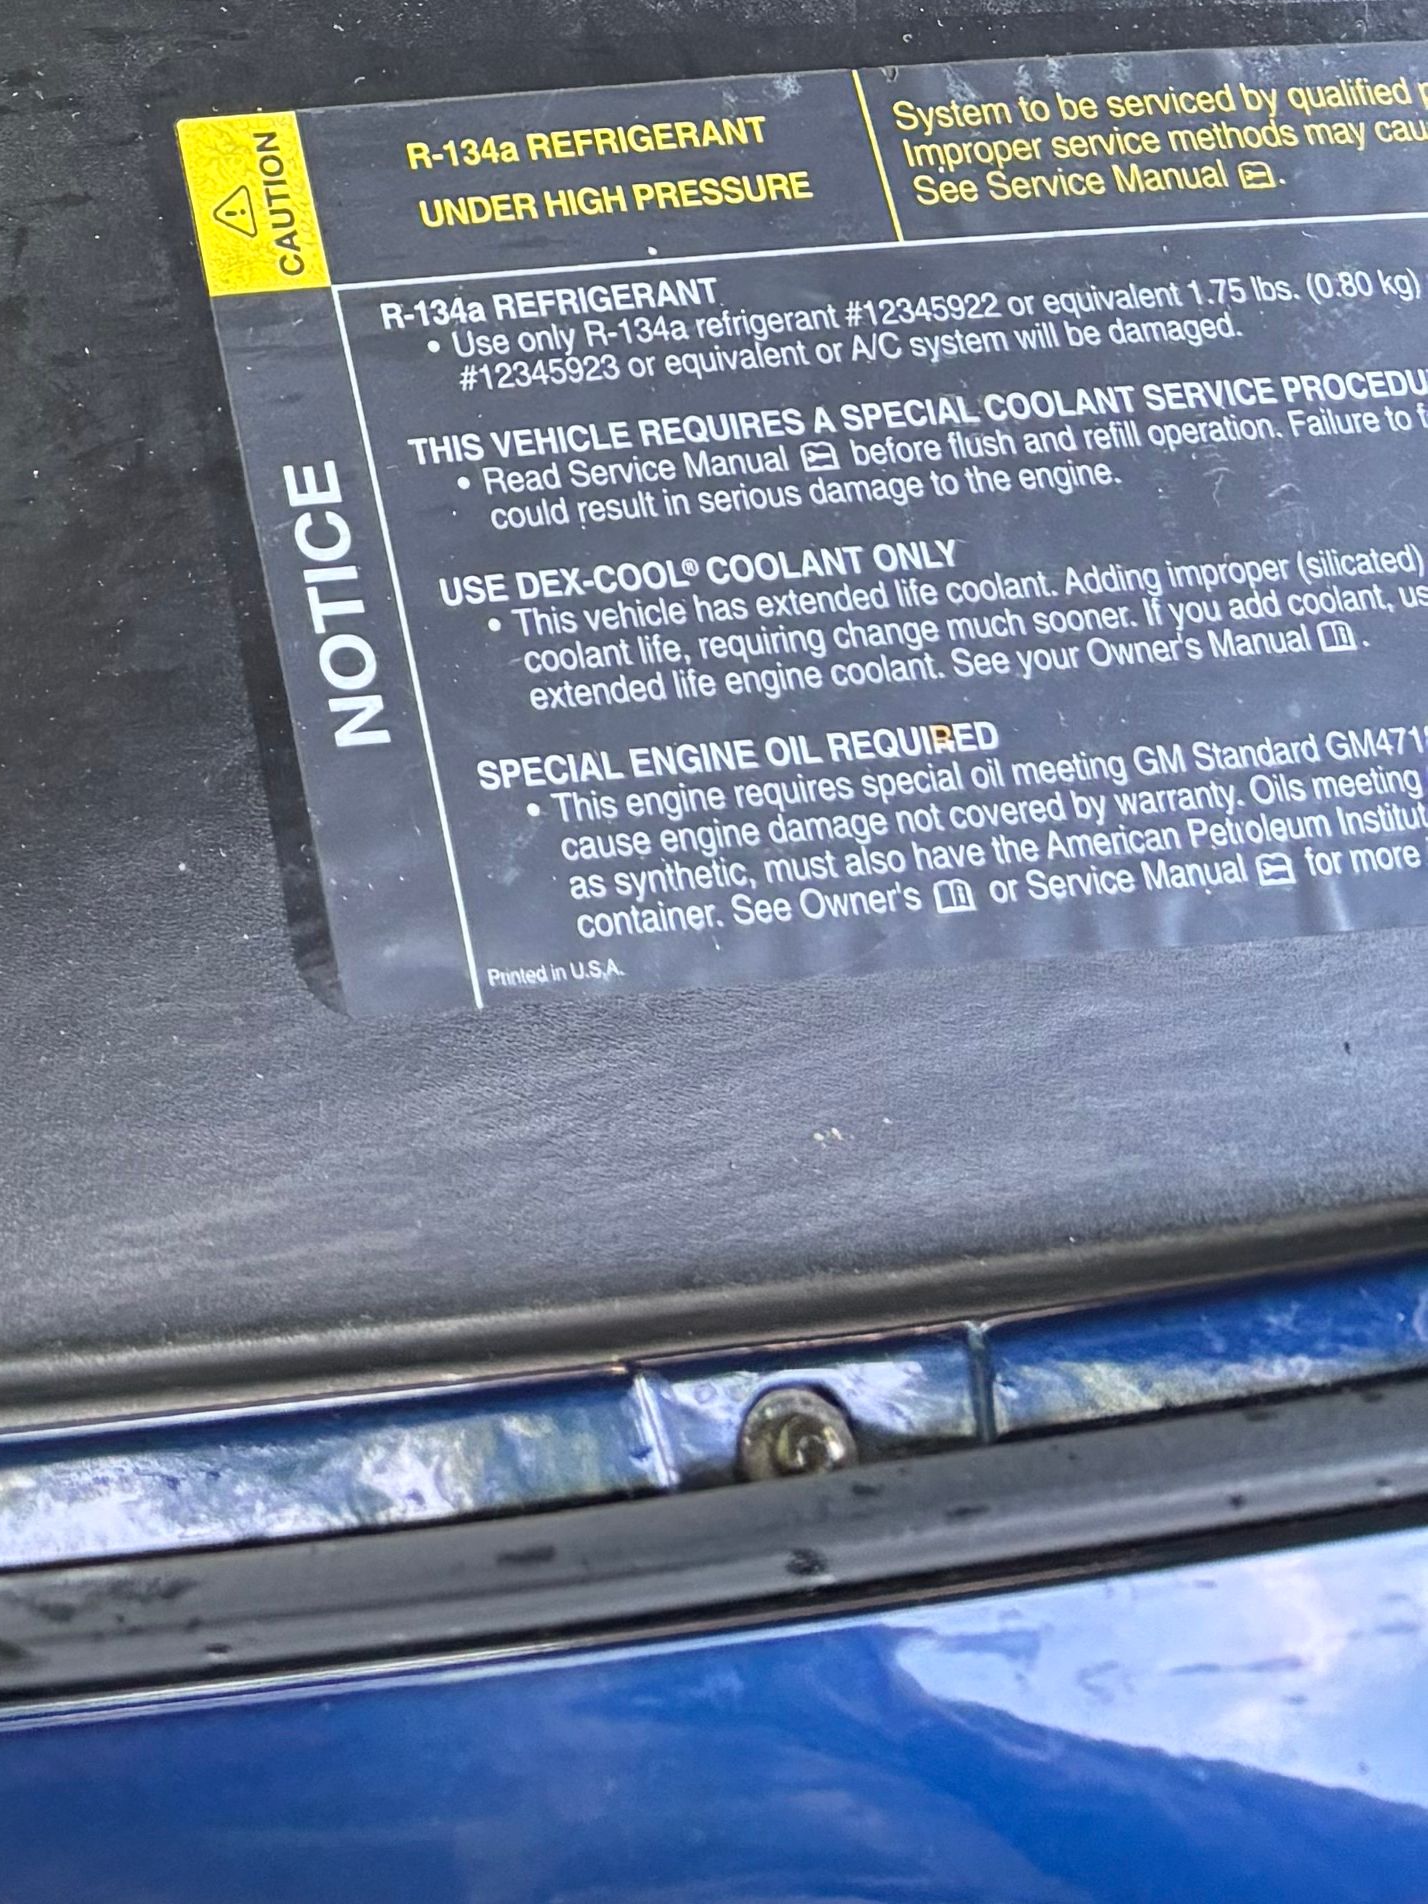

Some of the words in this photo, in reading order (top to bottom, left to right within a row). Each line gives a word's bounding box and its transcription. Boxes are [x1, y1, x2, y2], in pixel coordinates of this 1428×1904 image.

[891, 97, 1013, 136] System
[1017, 95, 1051, 127] to
[1055, 91, 1099, 121] be
[1105, 82, 1237, 118] serviced
[1238, 81, 1277, 118] by
[1286, 74, 1414, 115] qualified
[405, 136, 520, 170] R-134a
[525, 115, 766, 161] REFRIGERANT
[901, 136, 1042, 174] Improper
[1050, 125, 1162, 159] service
[1166, 118, 1300, 152] methods
[1303, 121, 1365, 147] may
[254, 131, 305, 278] CAUTION
[418, 192, 539, 228] UNDER
[543, 184, 628, 218] HIGH
[631, 170, 814, 211] PRESSURE
[912, 174, 979, 206] See
[985, 166, 1106, 201] Service
[1110, 157, 1230, 193] Manual
[379, 296, 487, 330] R-134a
[491, 276, 724, 321] REFRIGERANT
[450, 329, 511, 358] Use
[516, 322, 576, 355] only
[582, 314, 690, 348] R-134a
[694, 303, 841, 342] refrigerant
[844, 291, 1003, 328] #12345922
[1006, 294, 1035, 317] or
[1041, 281, 1184, 319] equivalent
[1186, 278, 1247, 305] 1.75
[1248, 274, 1301, 302] lbs.
[1305, 269, 1374, 304] (0.80
[1377, 267, 1422, 302] kg)
[458, 353, 621, 392] #12345923
[627, 355, 656, 379] or
[664, 339, 811, 380] equivalent
[814, 341, 843, 365] or
[851, 331, 903, 364] A/C
[908, 328, 1010, 364] system
[1012, 320, 1061, 350] will
[1062, 319, 1102, 347] be
[1107, 310, 1244, 346] damaged.
[406, 432, 485, 466] THIS
[489, 420, 634, 458] VEHICLE
[637, 407, 806, 447] REQUIRES
[813, 405, 838, 434] A
[839, 395, 981, 432] SPECIAL
[983, 384, 1135, 422] COOLANT
[1141, 376, 1279, 412] SERVICE
[1281, 367, 1428, 405] PROCEDU
[490, 496, 571, 530] could
[576, 489, 659, 524] result
[661, 487, 692, 516] in
[697, 481, 803, 514] serious
[808, 475, 925, 506] damage
[929, 469, 960, 497] to
[963, 464, 1012, 494] the
[1017, 458, 1123, 495] engine.
[282, 459, 392, 749] NOTICE
[438, 572, 510, 607] USE
[705, 545, 864, 585] COOLANT
[872, 538, 956, 573] ONLY
[529, 670, 668, 711] extended
[671, 667, 717, 700] life
[724, 660, 824, 698] engine
[829, 651, 946, 687] coolant.
[950, 646, 1011, 678] See
[1015, 645, 1080, 679] your
[1085, 631, 1204, 667] Owner's
[1206, 622, 1313, 659] Manual
[476, 750, 625, 791] SPECIAL
[628, 738, 761, 778] ENGINE
[764, 734, 824, 767] OIL
[825, 720, 1000, 763] REQUIRED
[560, 830, 652, 861] cause
[659, 817, 761, 856] engine
[767, 812, 889, 844] damage
[894, 802, 946, 834] not
[948, 790, 1068, 829] covered
[1069, 789, 1106, 826] by
[1112, 780, 1246, 816] warranty.
[1249, 772, 1307, 805] Oils
[1311, 766, 1424, 801] meeting
[486, 963, 550, 987] Printed
[549, 963, 568, 982] in
[569, 957, 626, 982] U.S.A.
